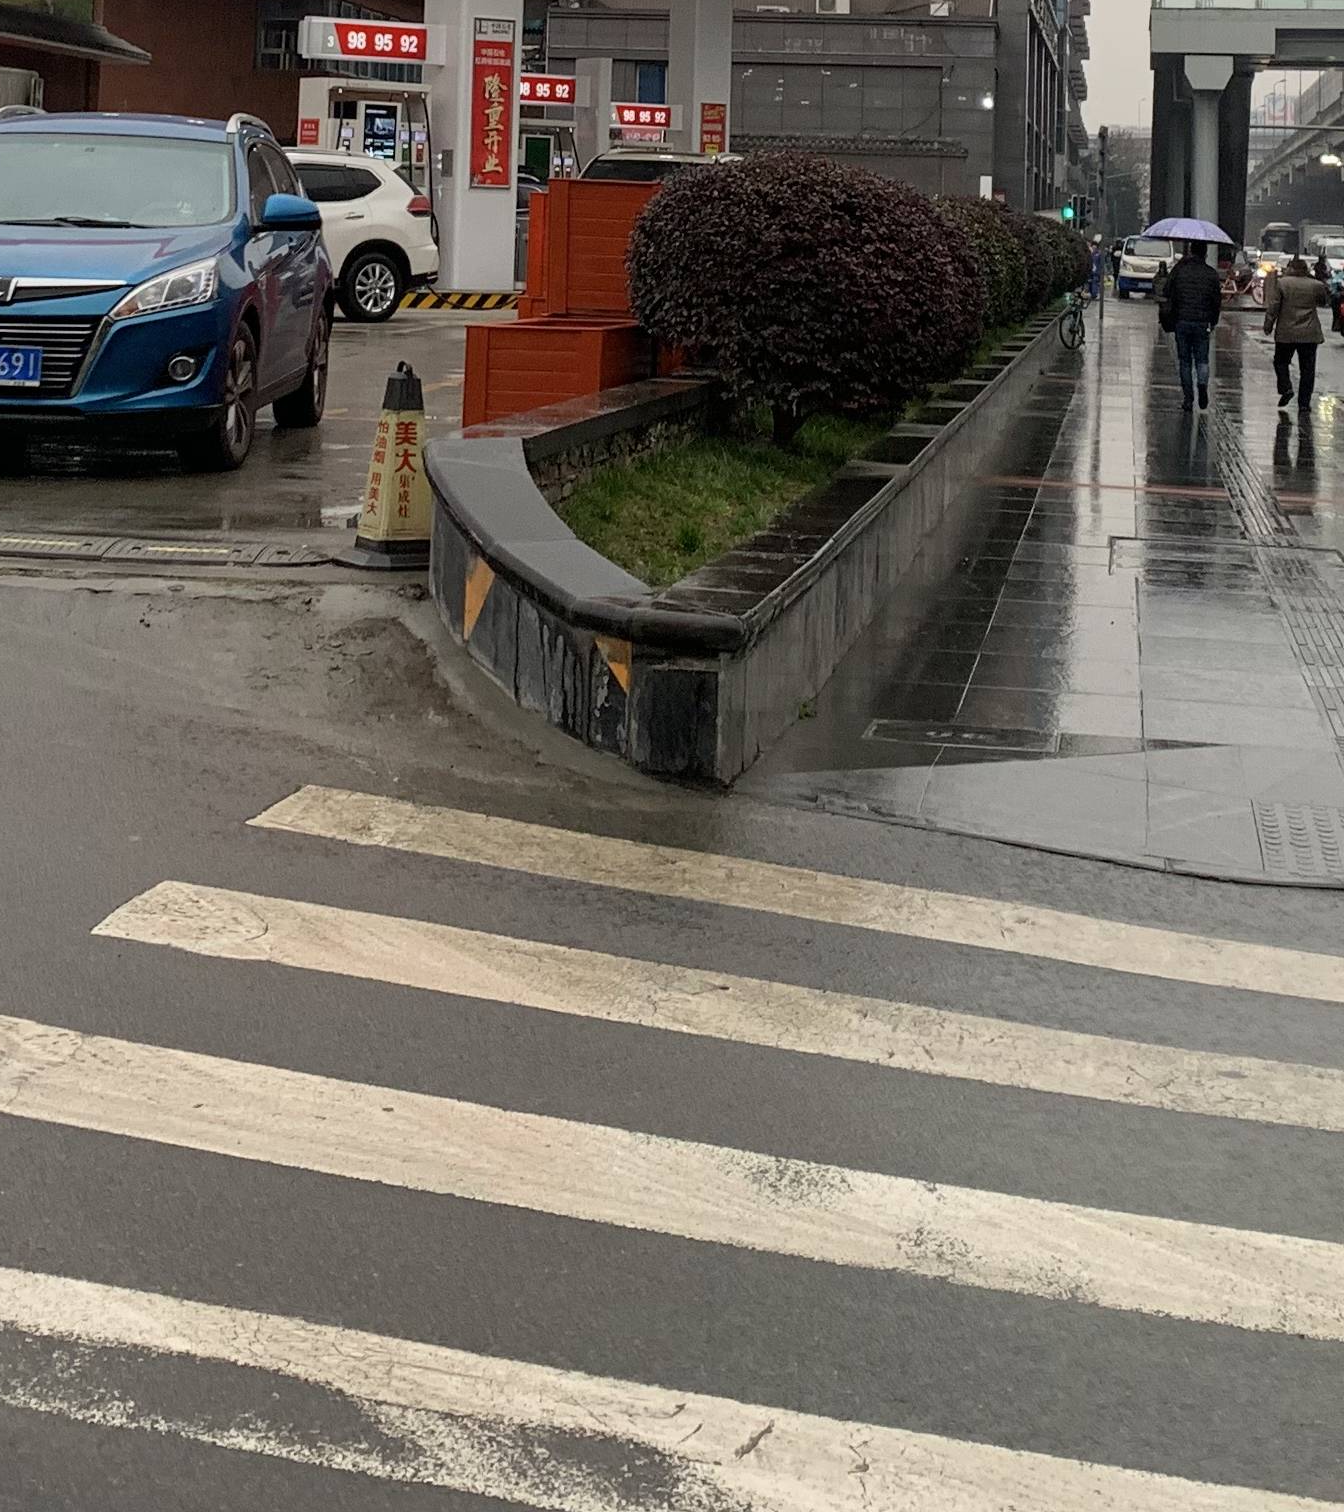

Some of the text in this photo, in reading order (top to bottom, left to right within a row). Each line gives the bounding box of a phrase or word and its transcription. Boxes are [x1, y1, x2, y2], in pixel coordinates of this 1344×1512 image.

[327, 30, 419, 53] 3 98 95 92
[536, 82, 551, 98] 95
[555, 83, 570, 99] 92
[481, 72, 509, 173] 隆重开业
[622, 109, 636, 122] 98
[639, 110, 652, 123] 95
[654, 111, 667, 124] 92
[394, 420, 418, 474] 美大
